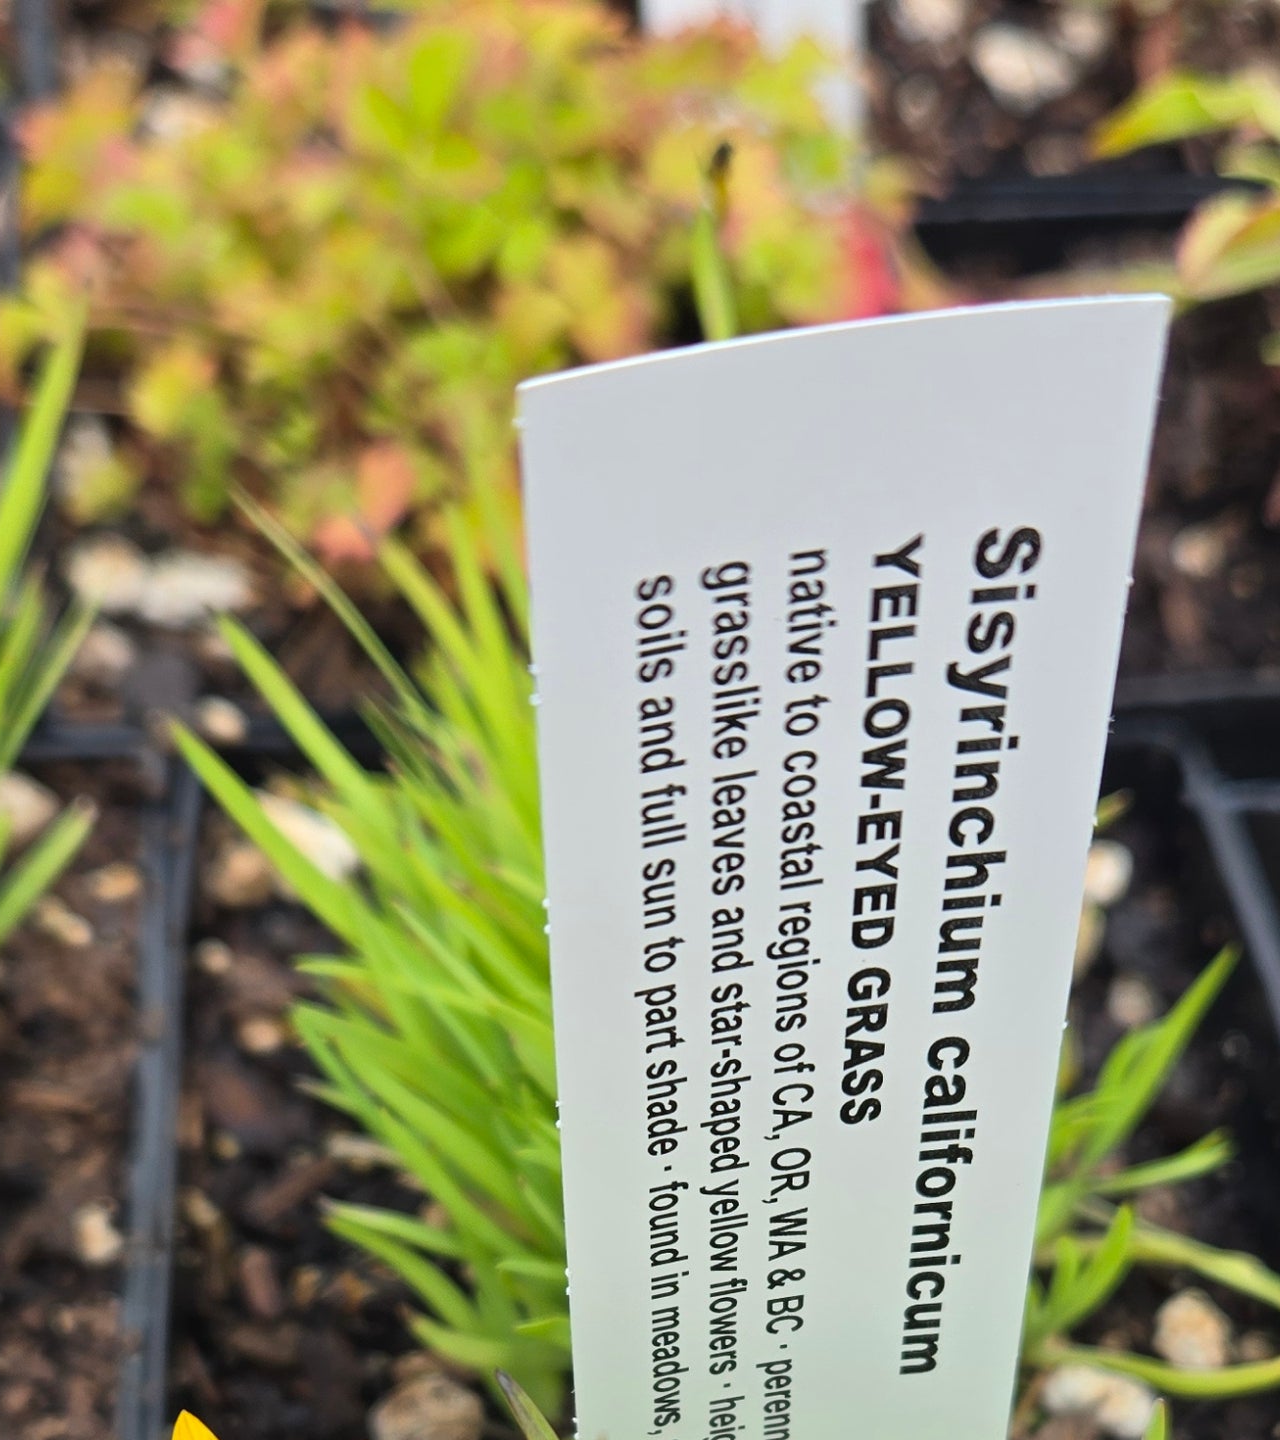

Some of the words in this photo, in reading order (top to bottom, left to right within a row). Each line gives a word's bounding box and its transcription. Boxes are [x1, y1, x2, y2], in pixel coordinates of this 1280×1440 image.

[636, 574, 687, 684] soils
[700, 561, 761, 760] grasslike
[785, 549, 837, 684] native
[639, 696, 687, 774] and
[784, 694, 830, 737] to
[851, 534, 924, 950] YELLOW-EYED
[640, 783, 688, 849] full
[932, 527, 1042, 1014] Sisyrinchium
[711, 770, 758, 896] leaves
[779, 750, 824, 891] coastal
[642, 858, 677, 930] sun
[643, 936, 686, 973] to
[711, 906, 755, 974] and
[765, 901, 821, 1033] regions
[633, 983, 686, 1055] part
[773, 1042, 816, 1075] of
[839, 966, 892, 1125] GRASS
[645, 1059, 688, 1157] shade
[699, 982, 752, 1174] star-shaped
[763, 1083, 815, 1141] CA,
[761, 1147, 812, 1204] OR,
[899, 1036, 978, 1375] californicum
[648, 1180, 689, 1268] found
[699, 1178, 749, 1272] yellow
[768, 1207, 809, 1262] WA
[650, 1270, 690, 1300] in
[765, 1294, 805, 1335] BC
[766, 1268, 807, 1290] &
[647, 1305, 690, 1436] meadows,
[708, 1277, 749, 1376] flowers
